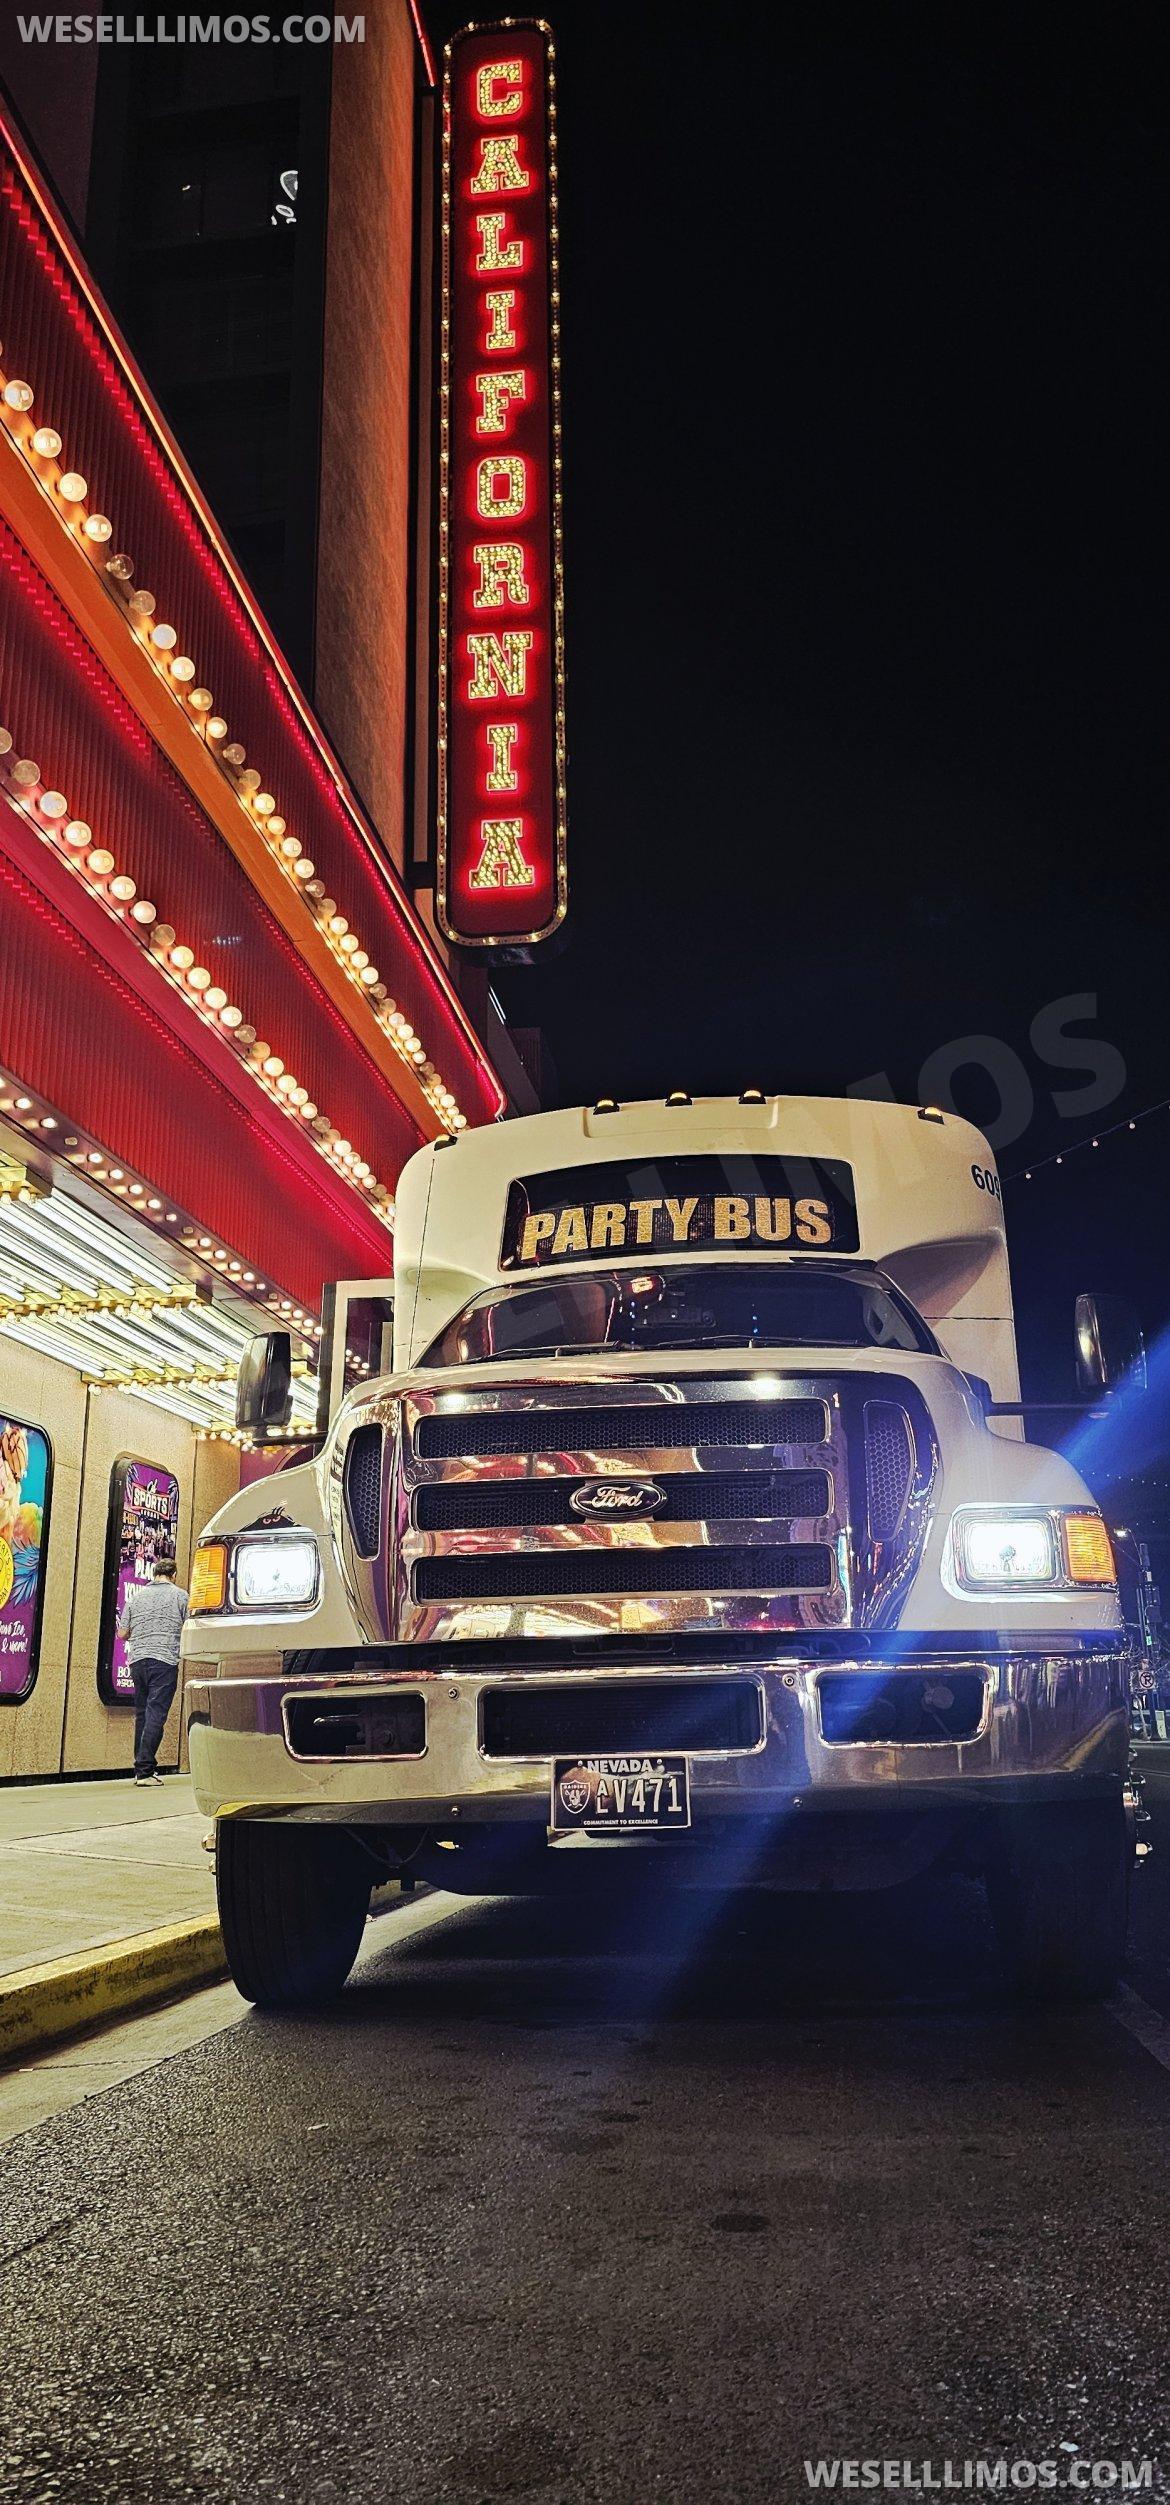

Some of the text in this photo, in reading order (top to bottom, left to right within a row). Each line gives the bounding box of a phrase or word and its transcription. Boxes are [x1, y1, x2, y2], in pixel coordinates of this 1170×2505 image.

[467, 60, 535, 889] CALIFORNIA
[520, 1197, 829, 1260] PARTY BUS
[133, 1487, 168, 1516] SPORTS
[591, 1486, 644, 1508] Ford
[587, 1759, 654, 1773] NEVADA
